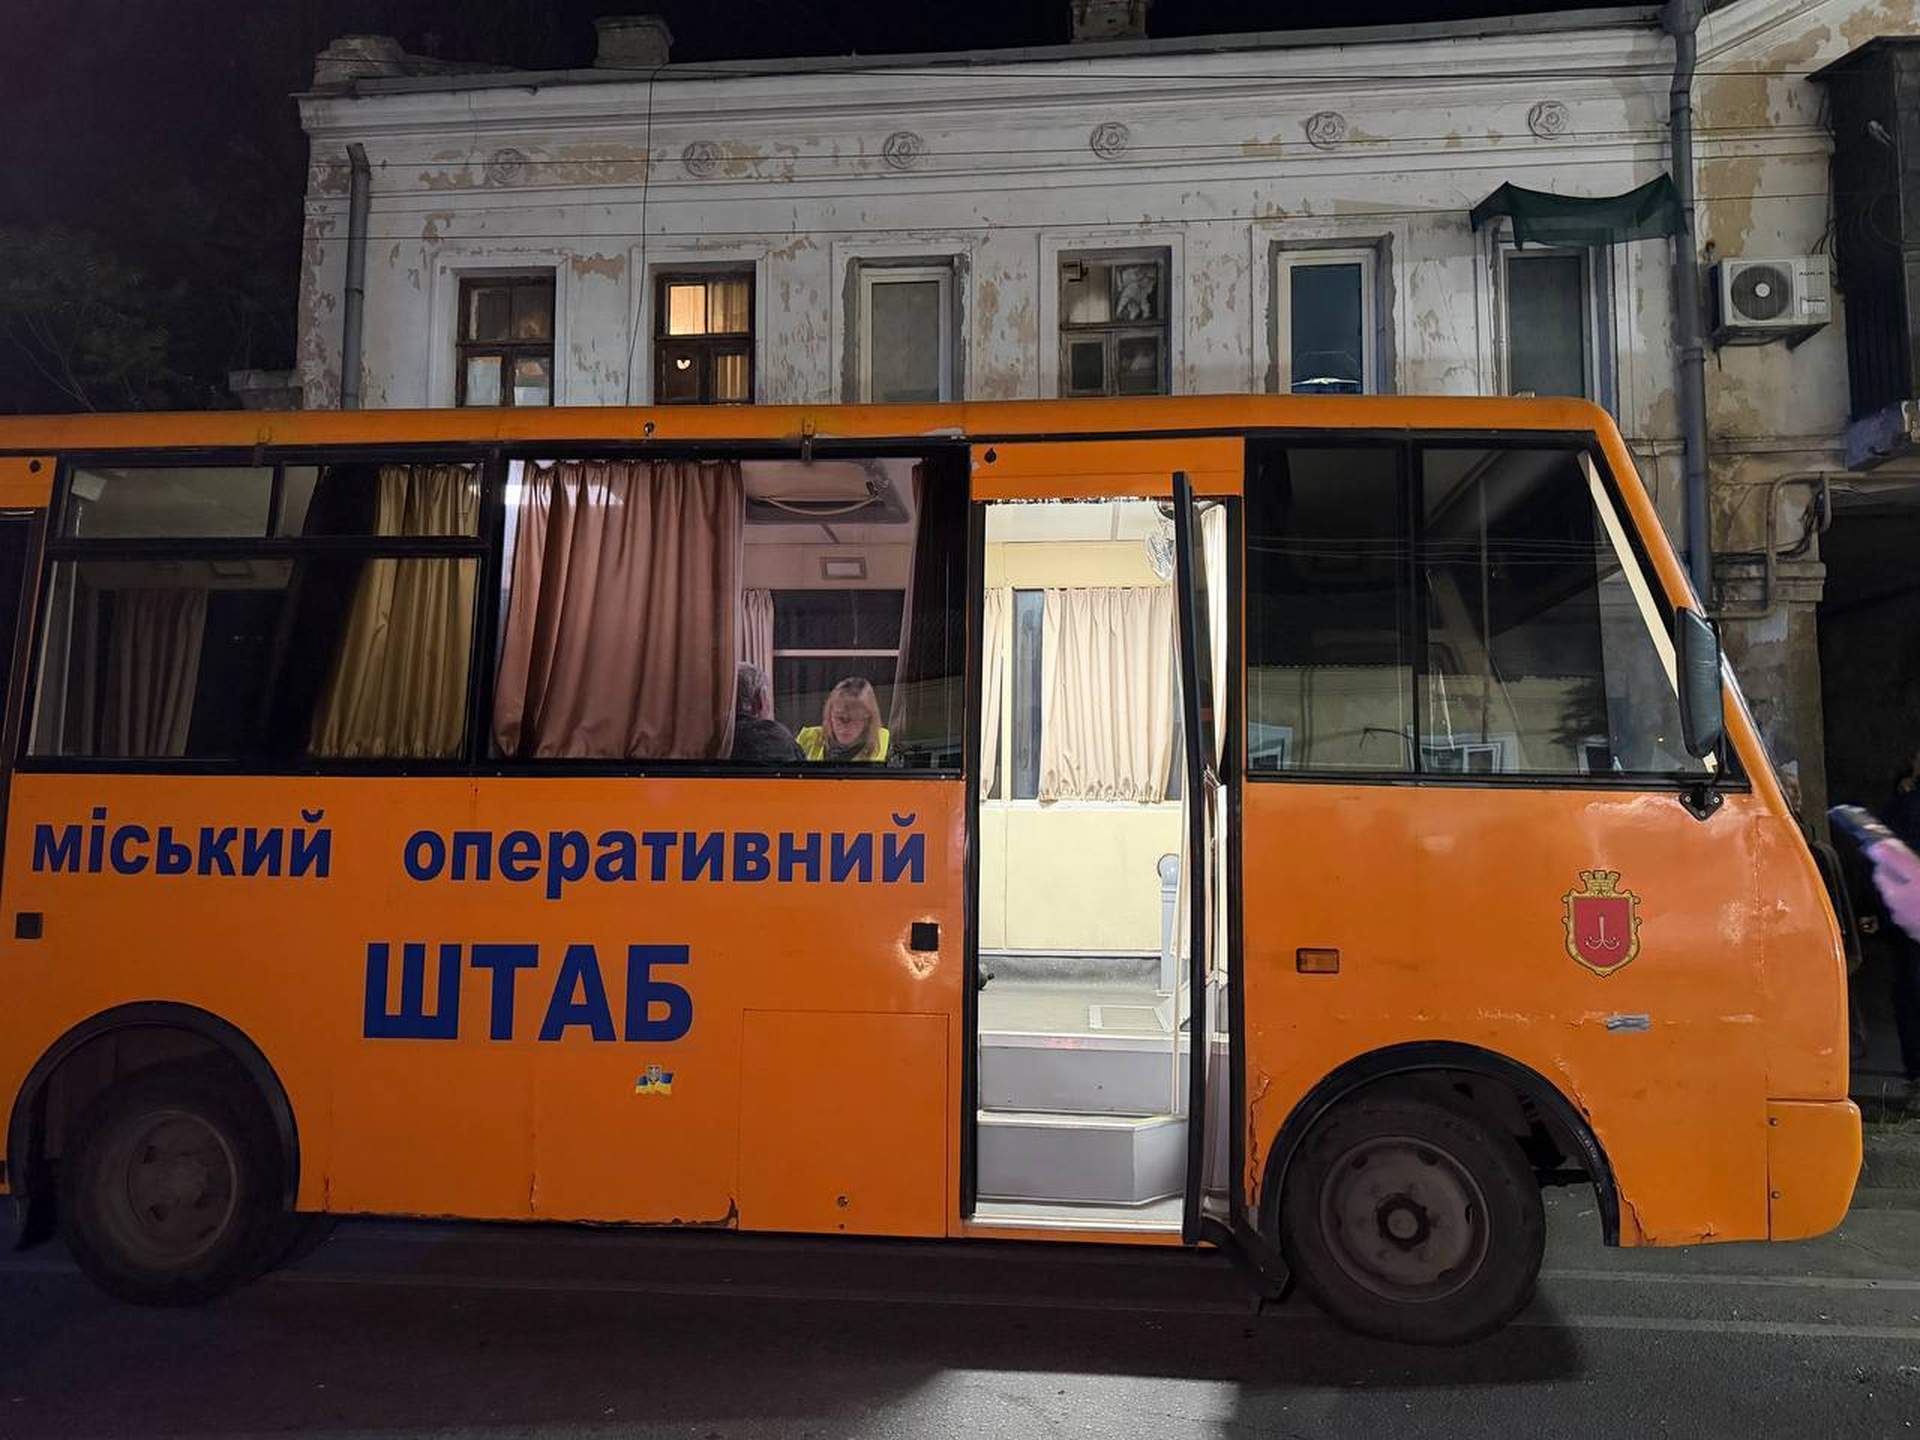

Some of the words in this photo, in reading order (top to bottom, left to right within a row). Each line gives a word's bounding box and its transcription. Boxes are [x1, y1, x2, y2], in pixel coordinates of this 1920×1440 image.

[33, 808, 332, 877] міський
[403, 813, 926, 900] оперативний
[363, 942, 694, 1042] ШТАБ
